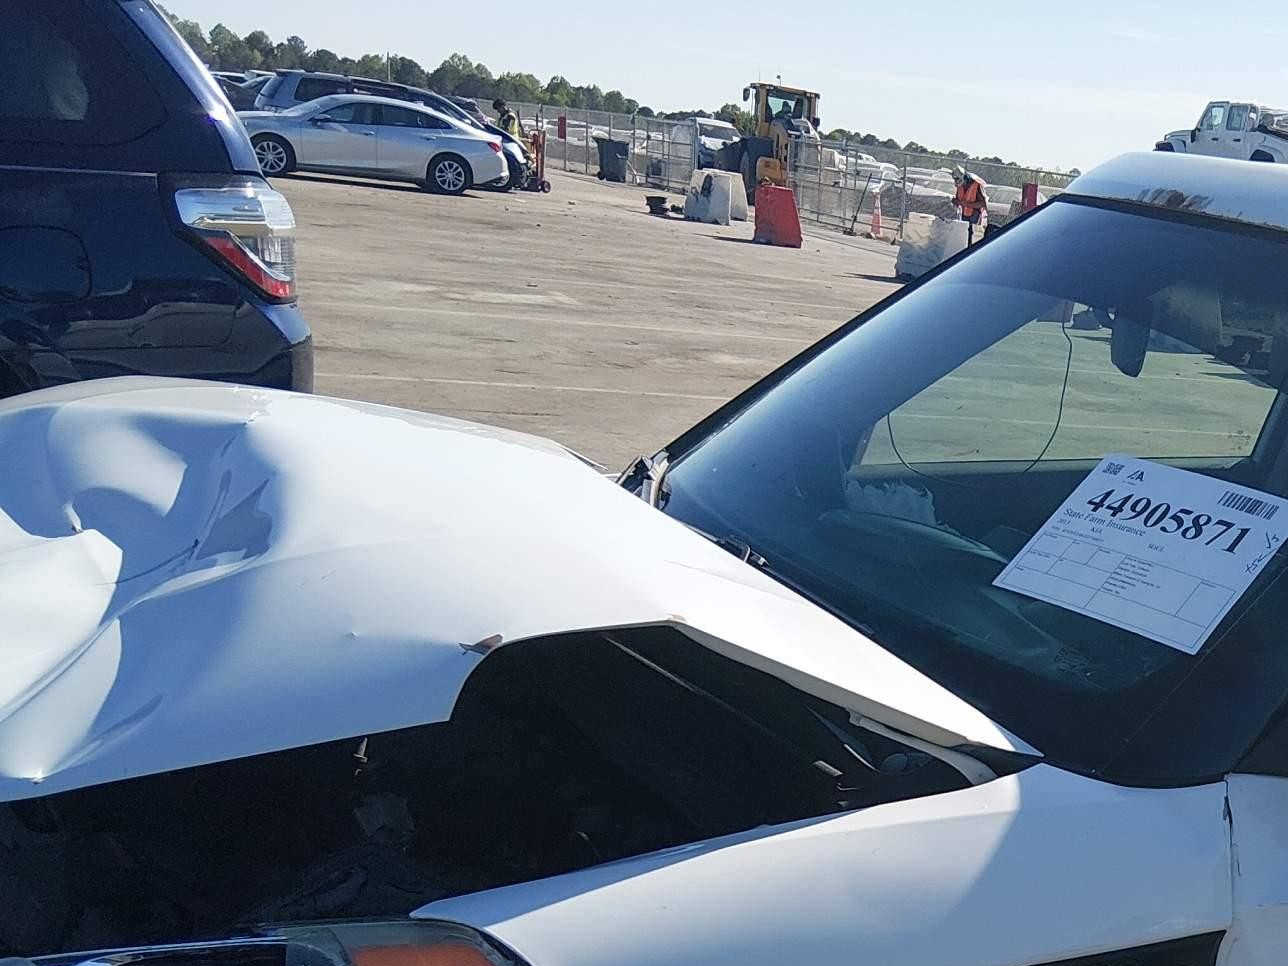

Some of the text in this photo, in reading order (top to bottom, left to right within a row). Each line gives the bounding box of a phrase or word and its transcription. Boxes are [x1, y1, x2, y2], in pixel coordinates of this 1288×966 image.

[1063, 507, 1084, 520] State
[1084, 513, 1106, 526] Farm
[1106, 518, 1147, 537] Insurance
[1087, 489, 1252, 555] 44905871
